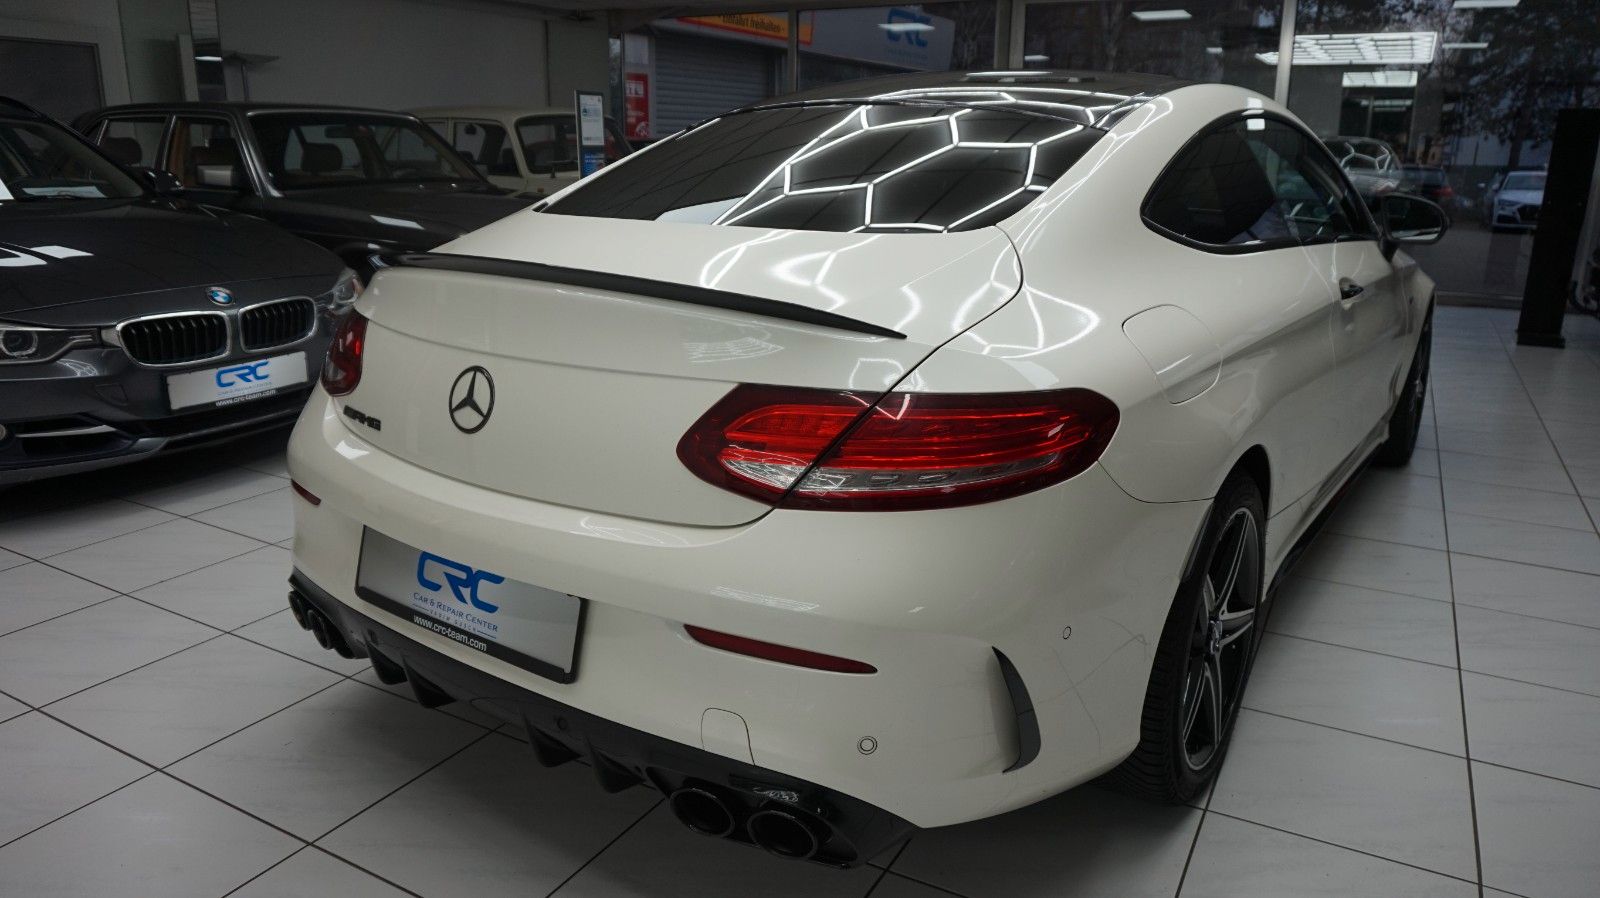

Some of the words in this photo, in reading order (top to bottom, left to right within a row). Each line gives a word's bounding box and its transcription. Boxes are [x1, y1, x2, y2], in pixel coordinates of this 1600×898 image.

[215, 360, 270, 388] CRC
[215, 389, 276, 407] www.crc-team.com
[343, 405, 381, 432] AMG
[417, 551, 505, 614] CRC
[436, 601, 463, 619] REPAIR
[466, 613, 498, 632] CENTER
[413, 614, 487, 652] www.crc-team.com
